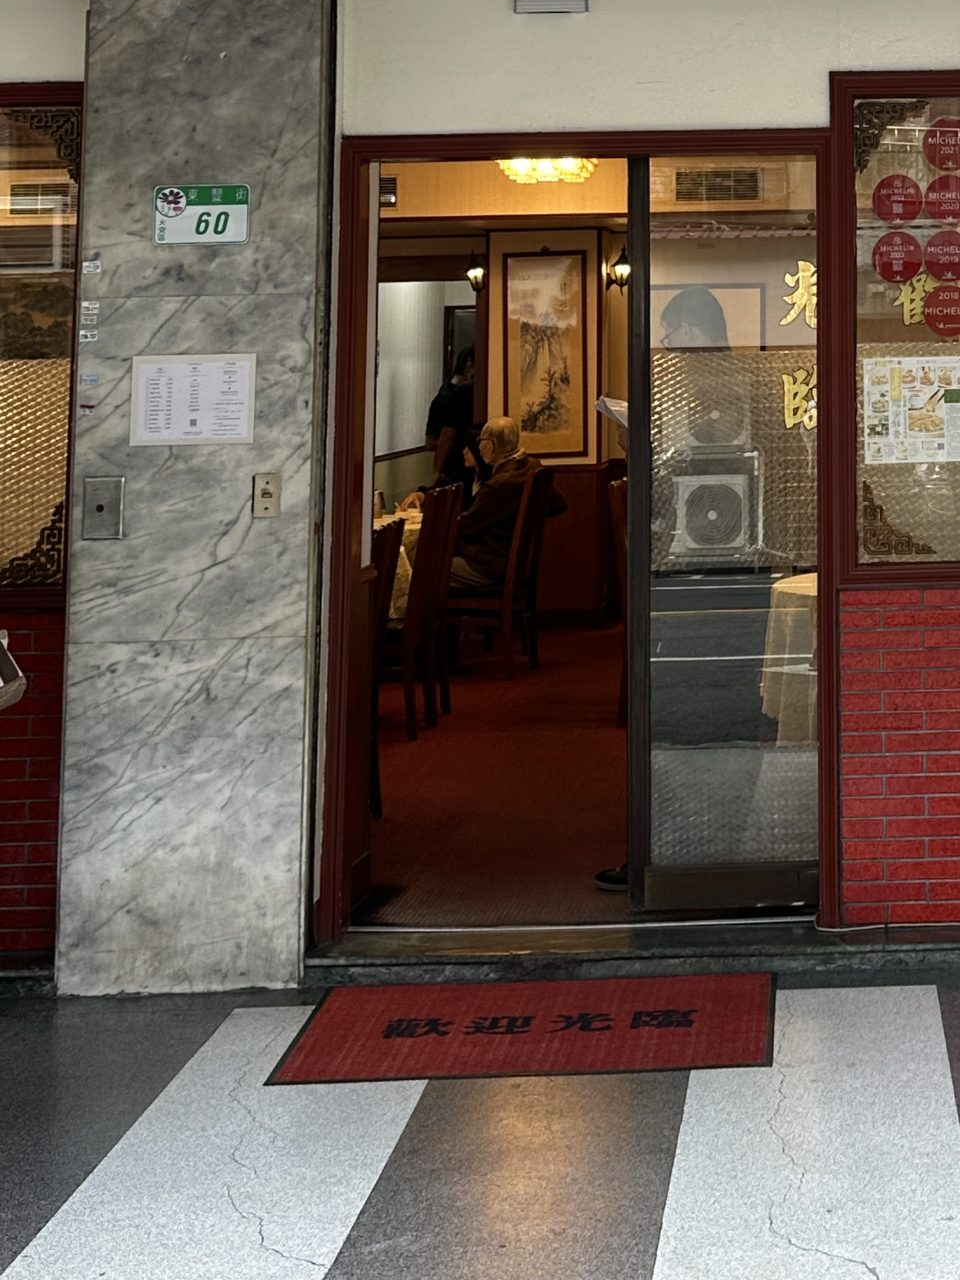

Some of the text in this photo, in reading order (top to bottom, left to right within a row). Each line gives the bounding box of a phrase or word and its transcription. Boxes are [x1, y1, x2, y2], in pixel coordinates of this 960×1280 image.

[940, 146, 959, 154] 2021
[195, 211, 230, 235] 60
[939, 256, 959, 264] 2019
[938, 292, 959, 300] 2018
[382, 1008, 699, 1040] 歡迎光臨
